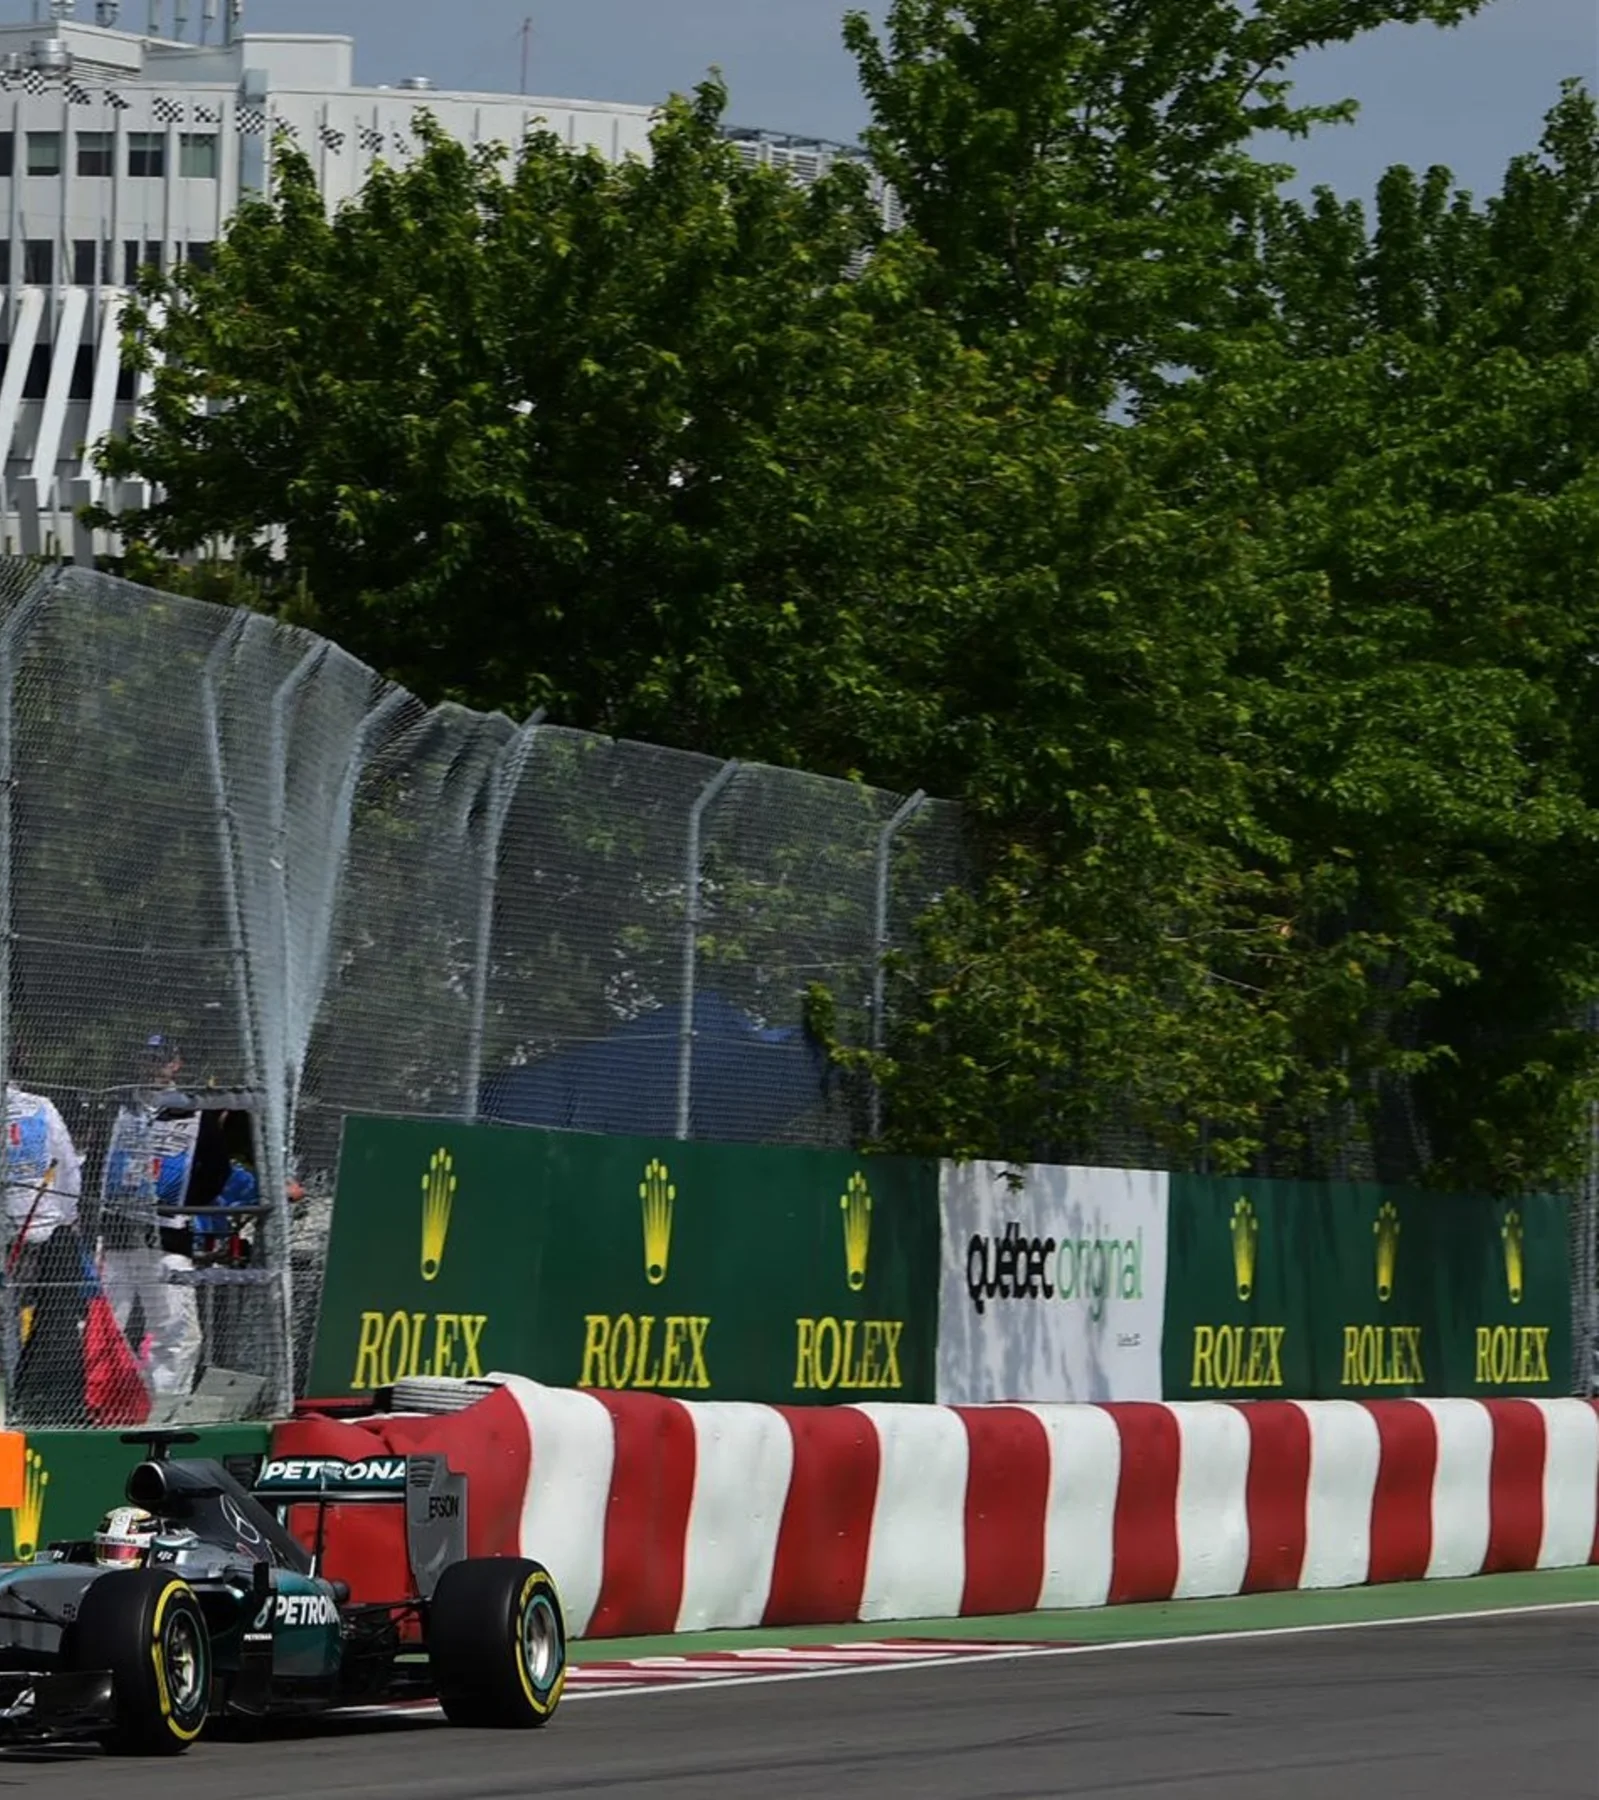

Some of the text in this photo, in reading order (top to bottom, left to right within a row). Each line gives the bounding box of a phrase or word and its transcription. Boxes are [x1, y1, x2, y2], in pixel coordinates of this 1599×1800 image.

[350, 1310, 488, 1389] ROLEX
[578, 1313, 712, 1389] ROLEX
[793, 1316, 904, 1389] ROLEX
[1190, 1325, 1286, 1388] ROLEX
[1341, 1325, 1425, 1386] ROLEX
[1475, 1325, 1549, 1384] ROLEX
